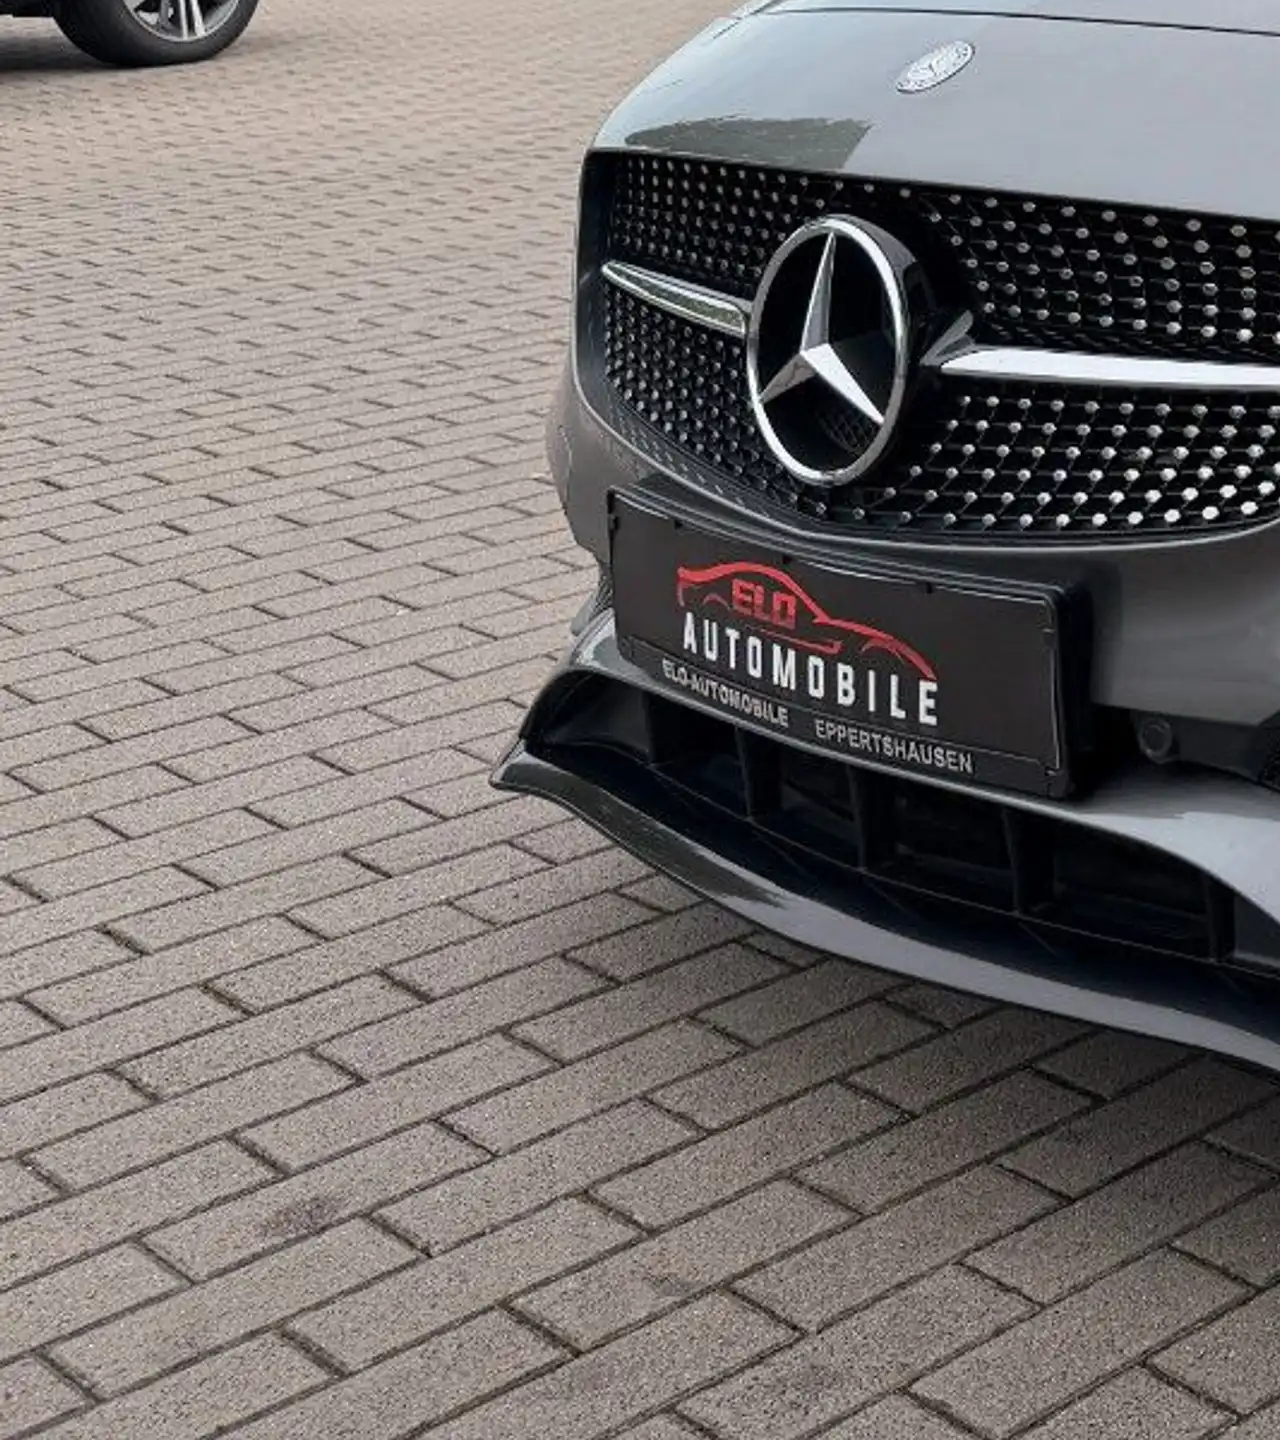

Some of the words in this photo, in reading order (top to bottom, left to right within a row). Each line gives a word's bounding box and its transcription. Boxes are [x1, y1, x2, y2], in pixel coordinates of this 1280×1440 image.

[731, 578, 797, 630] ELO
[662, 659, 790, 729] ELO-AUTOMOBILE
[815, 719, 974, 774] EPPERTSHAUSEN
[683, 612, 939, 727] AUTOMOBILE
